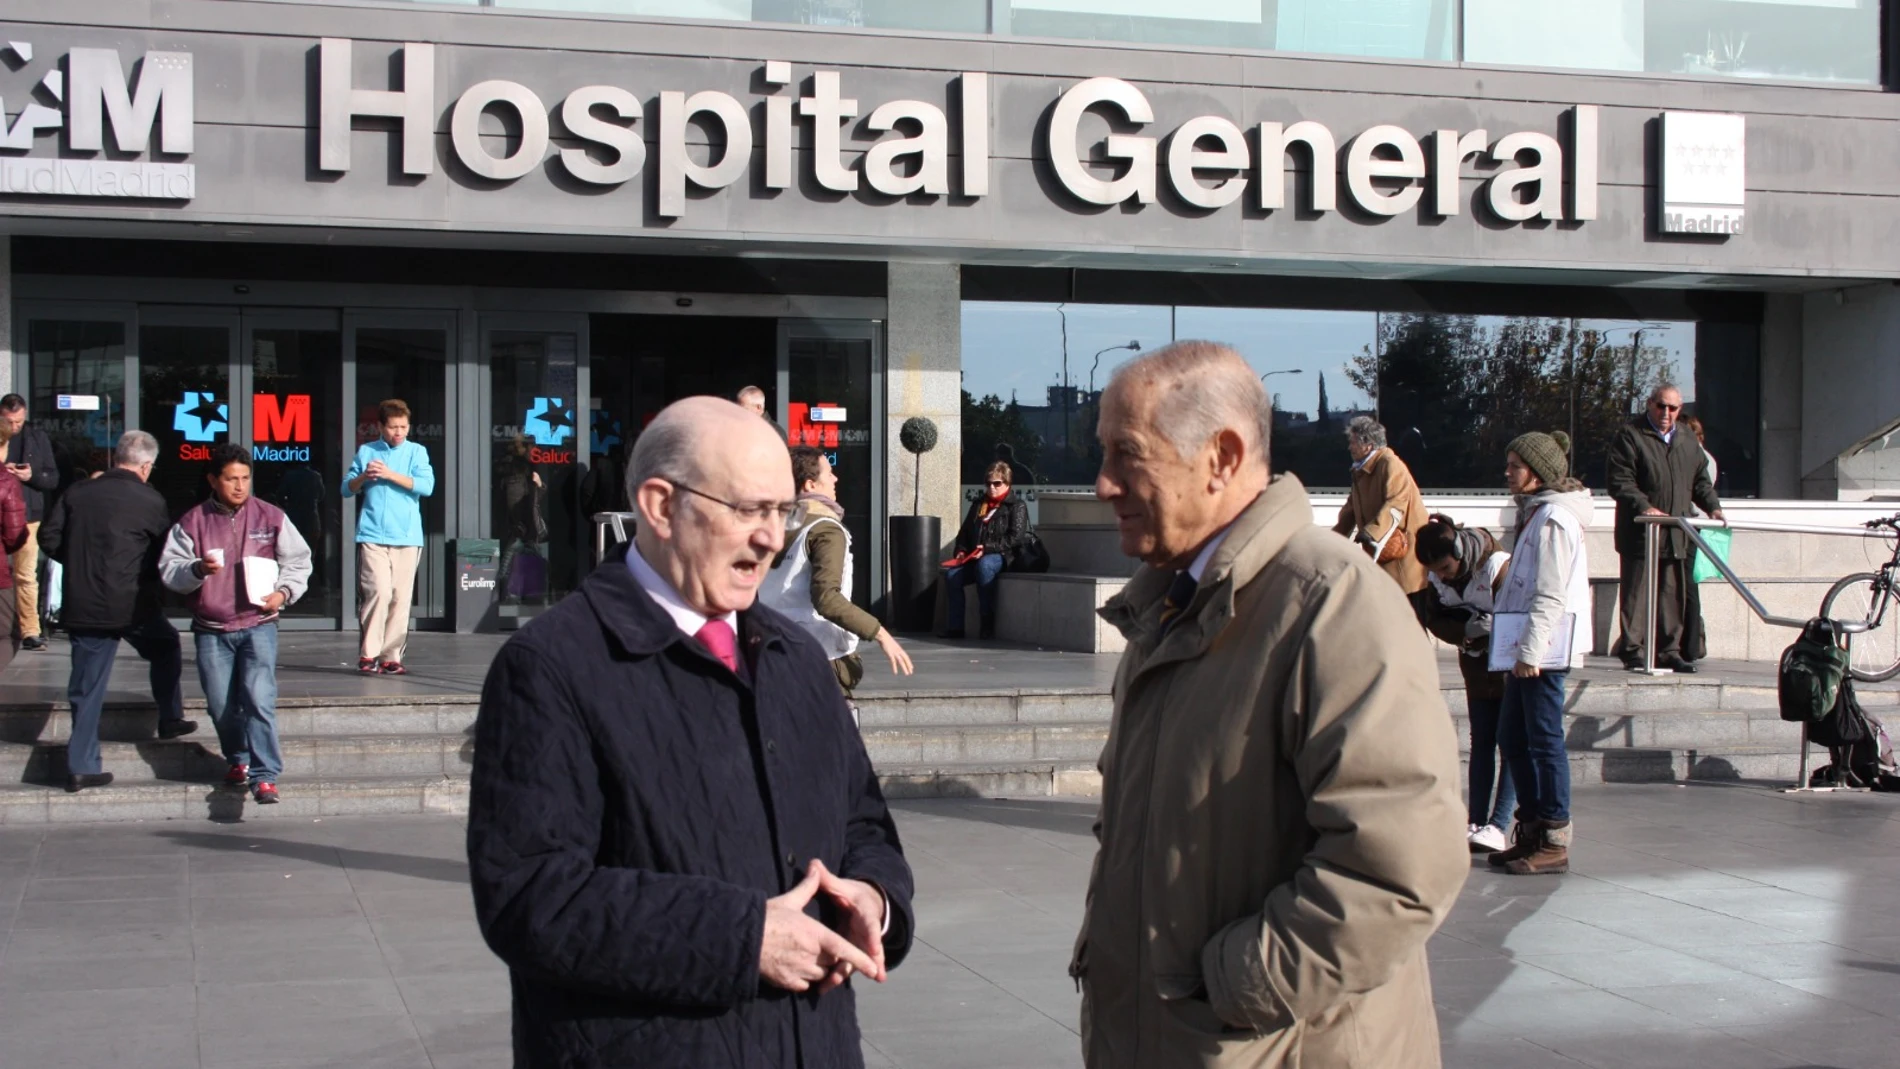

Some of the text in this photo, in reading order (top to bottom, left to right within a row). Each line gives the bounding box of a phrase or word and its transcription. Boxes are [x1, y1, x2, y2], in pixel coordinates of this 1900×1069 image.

[320, 38, 1598, 222] Hospital General
[1664, 213, 1744, 234] Madrid
[180, 444, 213, 460] Salu
[254, 446, 310, 461] Madrid
